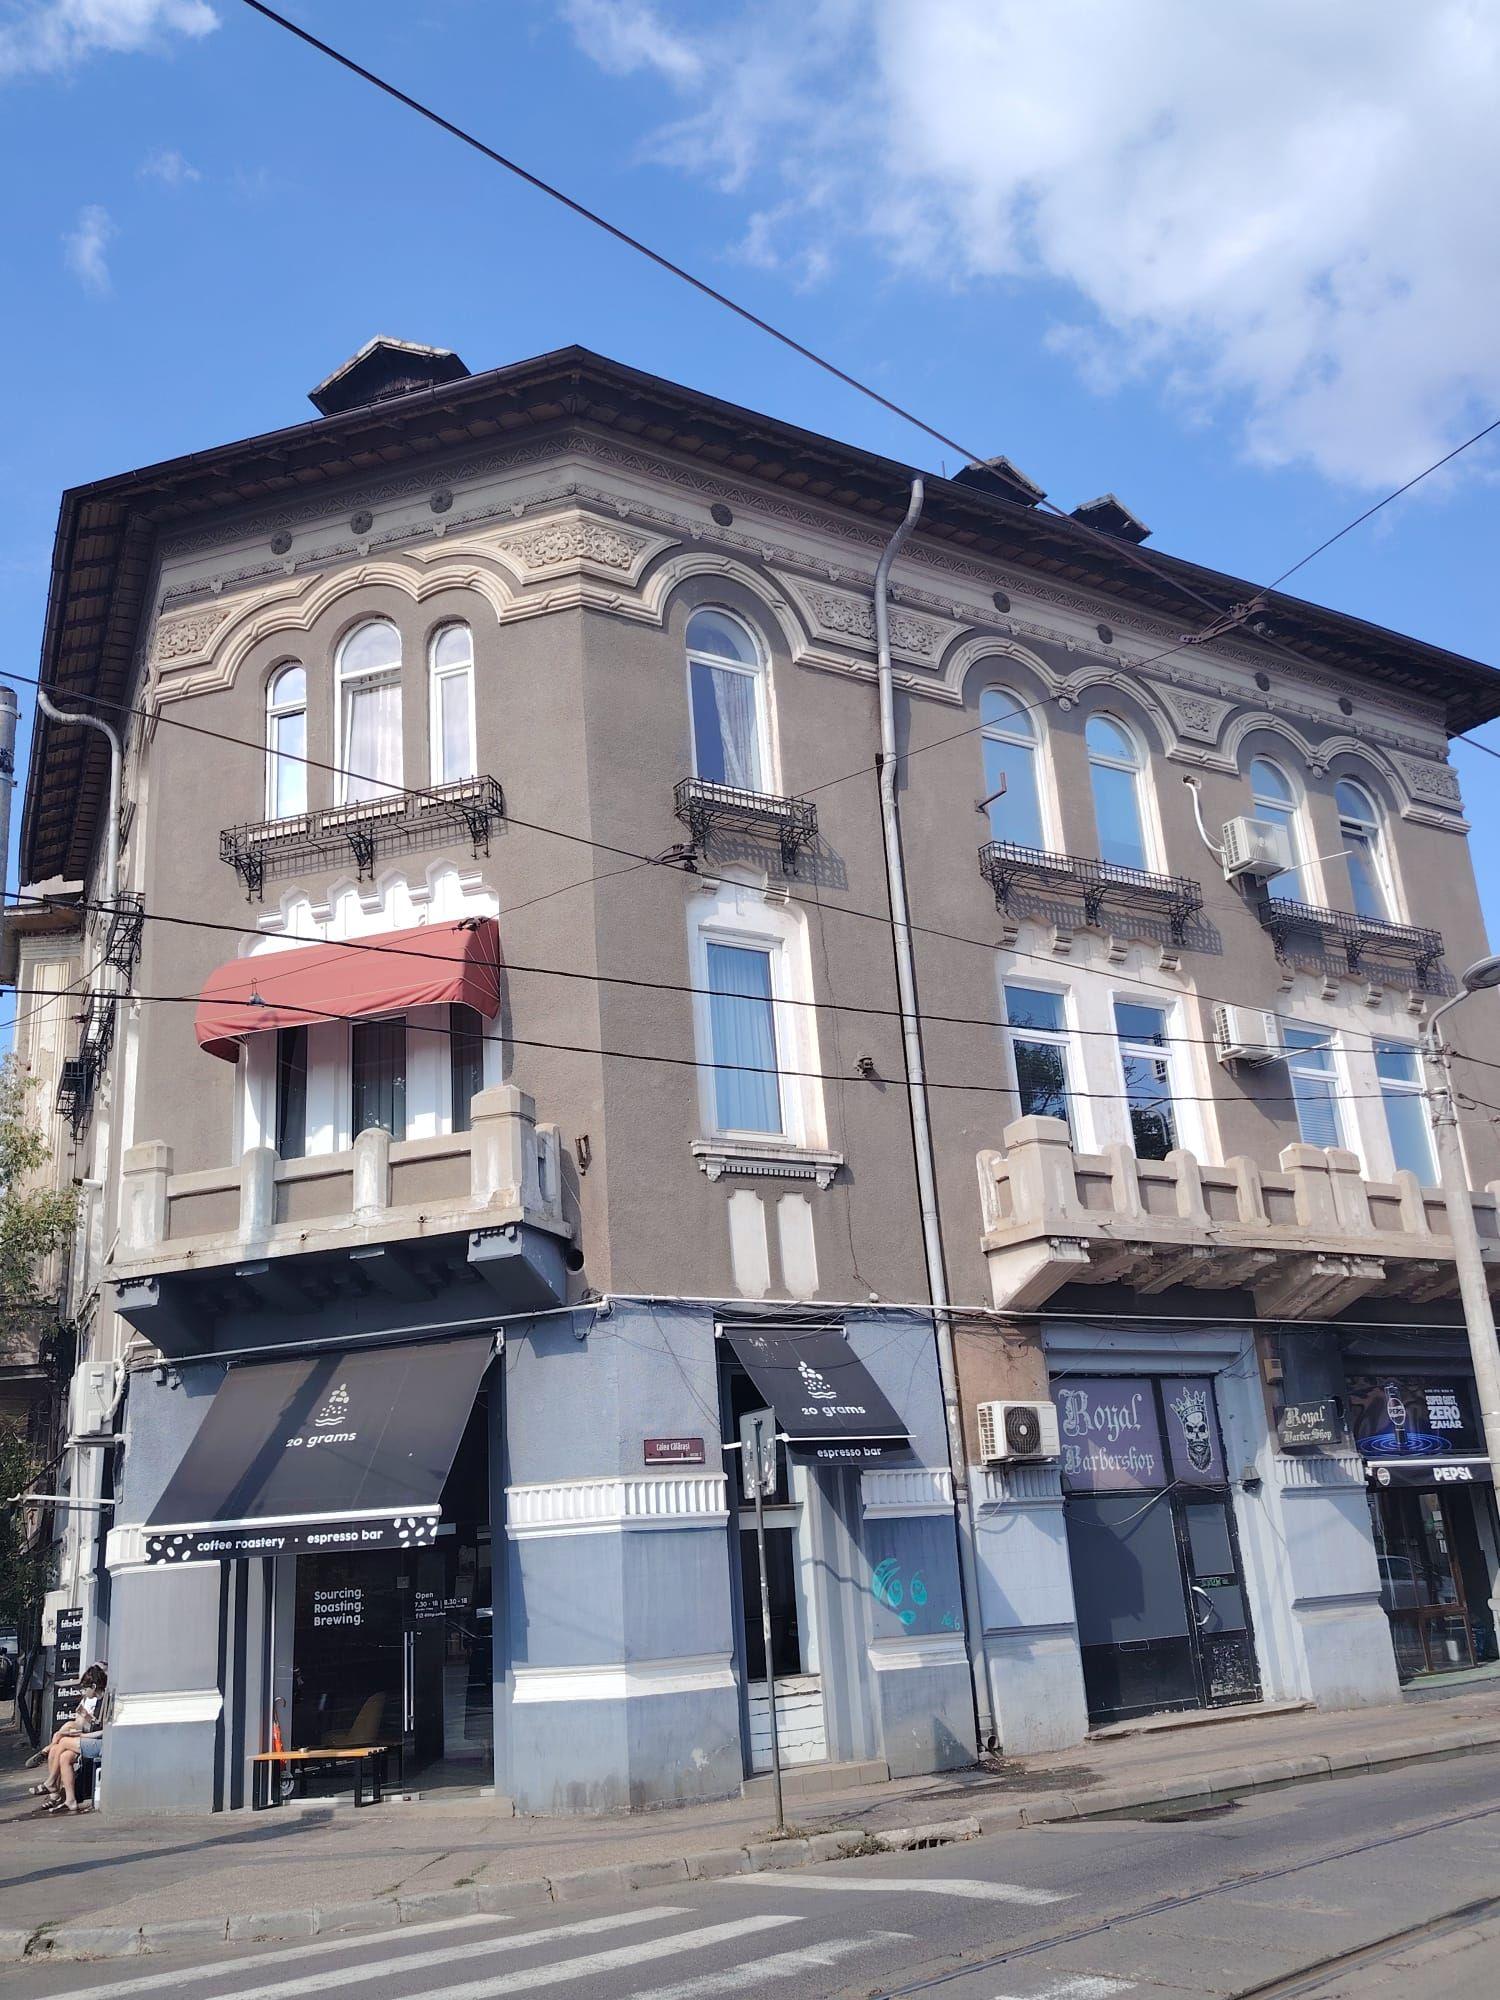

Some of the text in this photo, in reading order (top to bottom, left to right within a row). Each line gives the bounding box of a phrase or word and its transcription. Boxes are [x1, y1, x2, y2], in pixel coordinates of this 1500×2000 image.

[802, 1406, 866, 1417] 20 grams
[1058, 1388, 1142, 1442] Royal
[1284, 1405, 1326, 1428] Royal
[1427, 1406, 1460, 1420] ZERO
[286, 1432, 357, 1448] 20 grams
[817, 1447, 882, 1459] espresso bar
[1061, 1444, 1155, 1476] Barbershop
[1433, 1466, 1473, 1482] PEPSI
[197, 1529, 384, 1551] coffee roastery espresso bar
[314, 1587, 365, 1600] Sourcing.
[415, 1592, 434, 1600] Open
[314, 1600, 365, 1613] Roasting.
[313, 1613, 365, 1627] Brewing.
